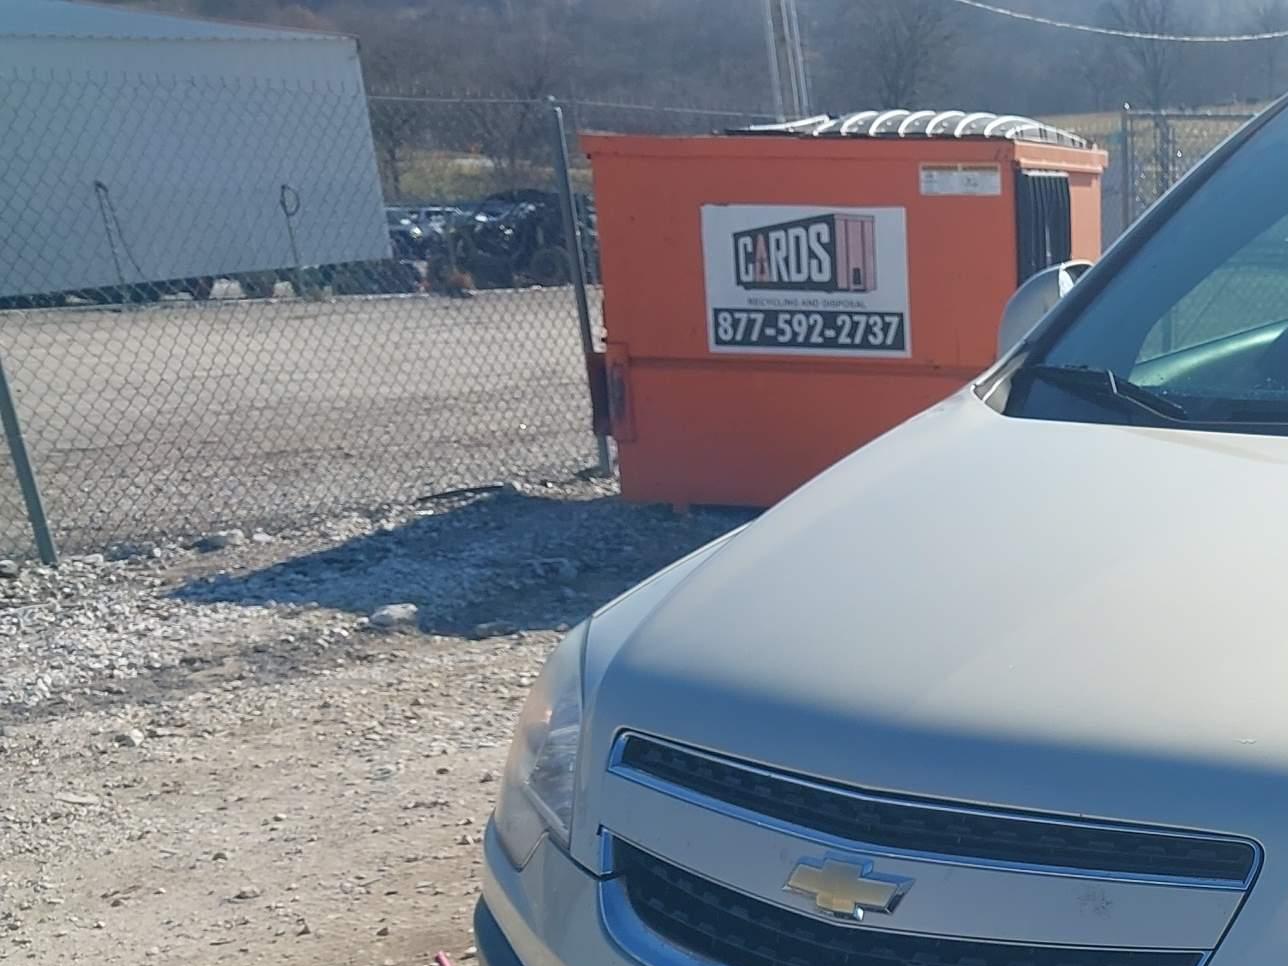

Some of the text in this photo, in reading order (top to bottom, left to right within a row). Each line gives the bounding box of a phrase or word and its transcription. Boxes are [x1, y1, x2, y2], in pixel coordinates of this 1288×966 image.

[737, 222, 832, 283] CARDS
[802, 298, 819, 307] AND
[823, 299, 867, 308] DISPOSAL
[717, 311, 900, 345] 877-592-2737
